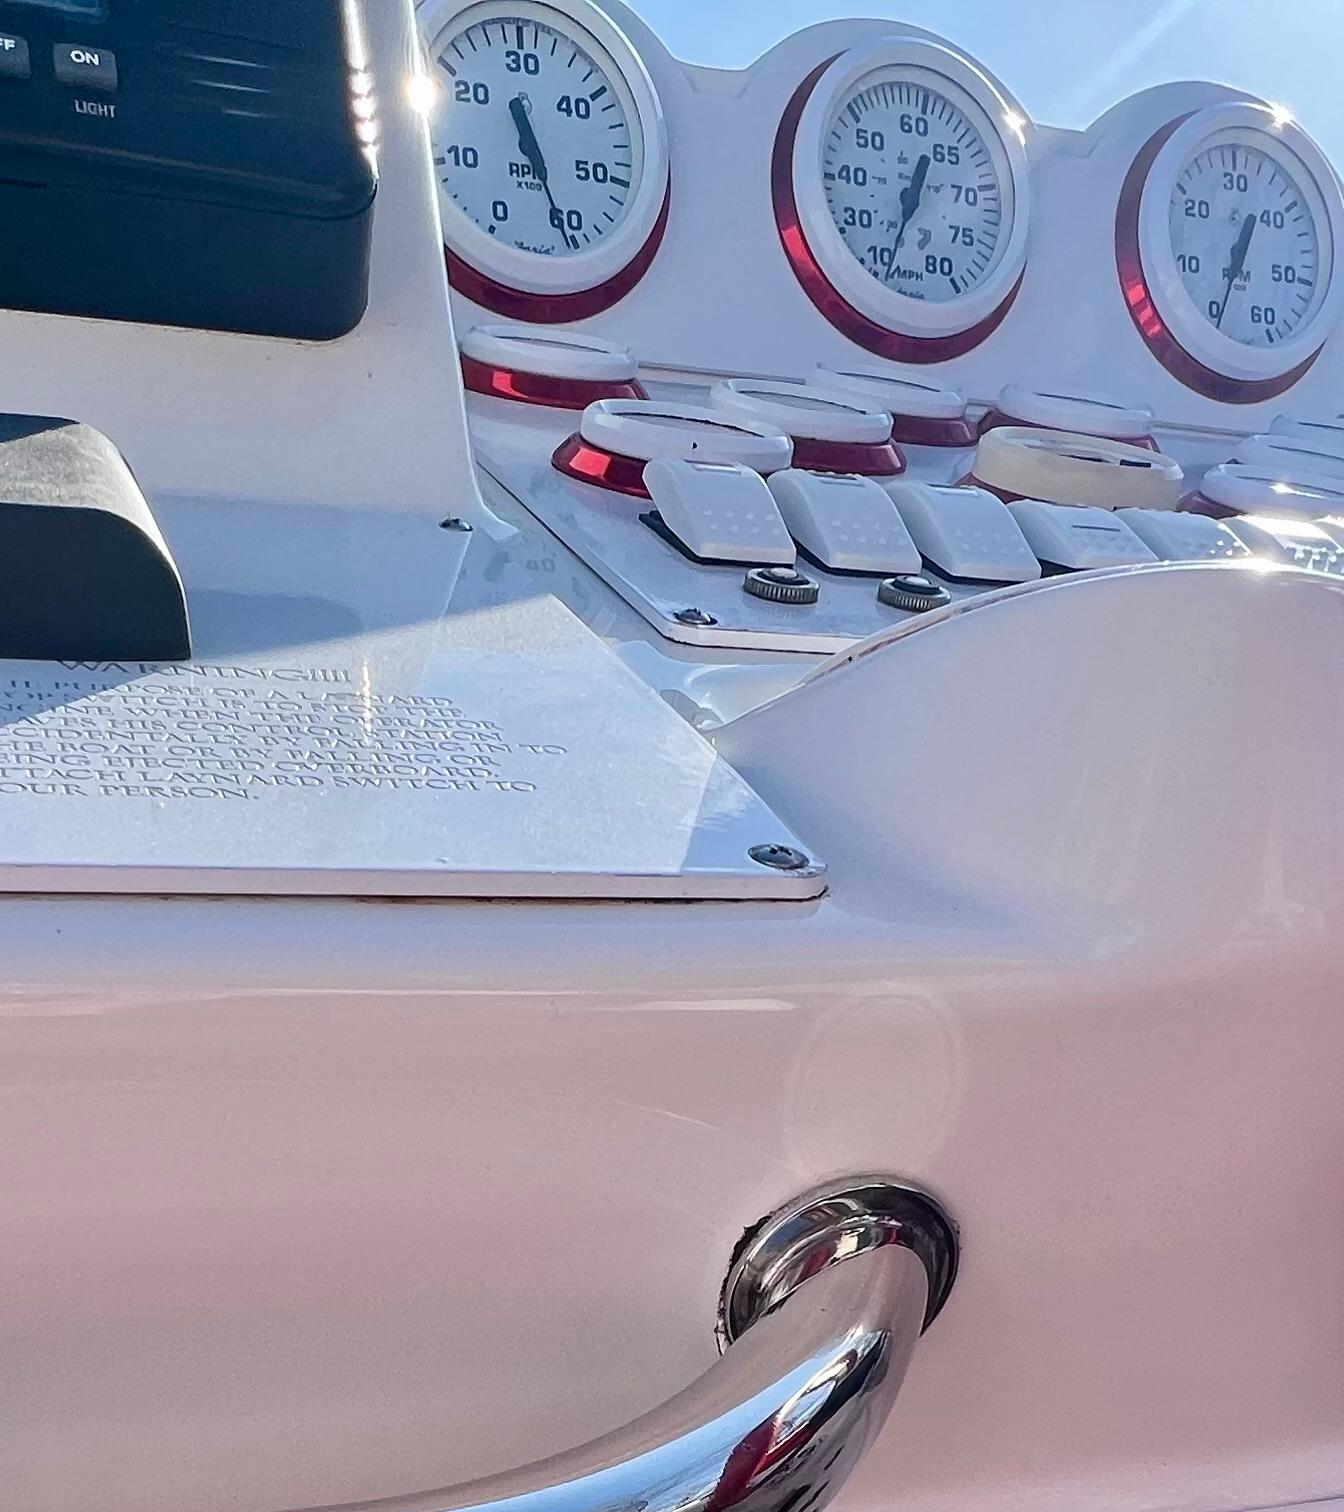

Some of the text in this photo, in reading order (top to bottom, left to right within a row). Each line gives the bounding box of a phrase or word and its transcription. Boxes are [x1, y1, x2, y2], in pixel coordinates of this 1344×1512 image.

[70, 50, 100, 66] ON
[504, 50, 540, 76] 30
[454, 80, 490, 105] 20
[74, 99, 116, 118] LIGHT
[556, 95, 591, 120] 40
[899, 114, 929, 137] 60
[855, 129, 885, 151] 50
[446, 145, 479, 168] 10
[932, 144, 960, 165] 65
[575, 159, 609, 183] 50
[837, 164, 868, 187] 40
[1223, 172, 1248, 192] 30
[950, 184, 978, 206] 70
[491, 200, 509, 222] 0
[843, 207, 873, 229] 30
[1184, 199, 1210, 219] 20
[1259, 210, 1285, 229] 40
[548, 209, 583, 231] 60
[948, 225, 975, 247] 75
[867, 246, 894, 267] 10
[925, 255, 954, 276] 80
[1176, 254, 1200, 273] 10
[1222, 268, 1251, 282] RM
[1271, 265, 1295, 284] 50
[1208, 301, 1221, 319] 0
[1250, 305, 1275, 325] 60
[267, 690, 290, 701] A
[122, 708, 240, 722] WHEN
[246, 711, 320, 725] THE
[217, 699, 246, 710] IS
[252, 700, 303, 711] TO
[396, 705, 465, 718] THE
[106, 719, 166, 731] HIS
[56, 743, 156, 757] BOAT
[165, 745, 223, 759] OR
[229, 749, 273, 761] BY
[285, 750, 442, 767] FALLING
[446, 755, 502, 768] OR
[260, 736, 302, 748] BY
[313, 737, 464, 753] FALLING
[518, 744, 568, 757] TO
[101, 756, 265, 773] EJECTED
[273, 763, 499, 780] OVERBOARD.
[98, 784, 259, 802] PERSON.
[136, 772, 324, 788] LAYNARD
[331, 776, 479, 791] SWITCH
[485, 781, 537, 793] TO
